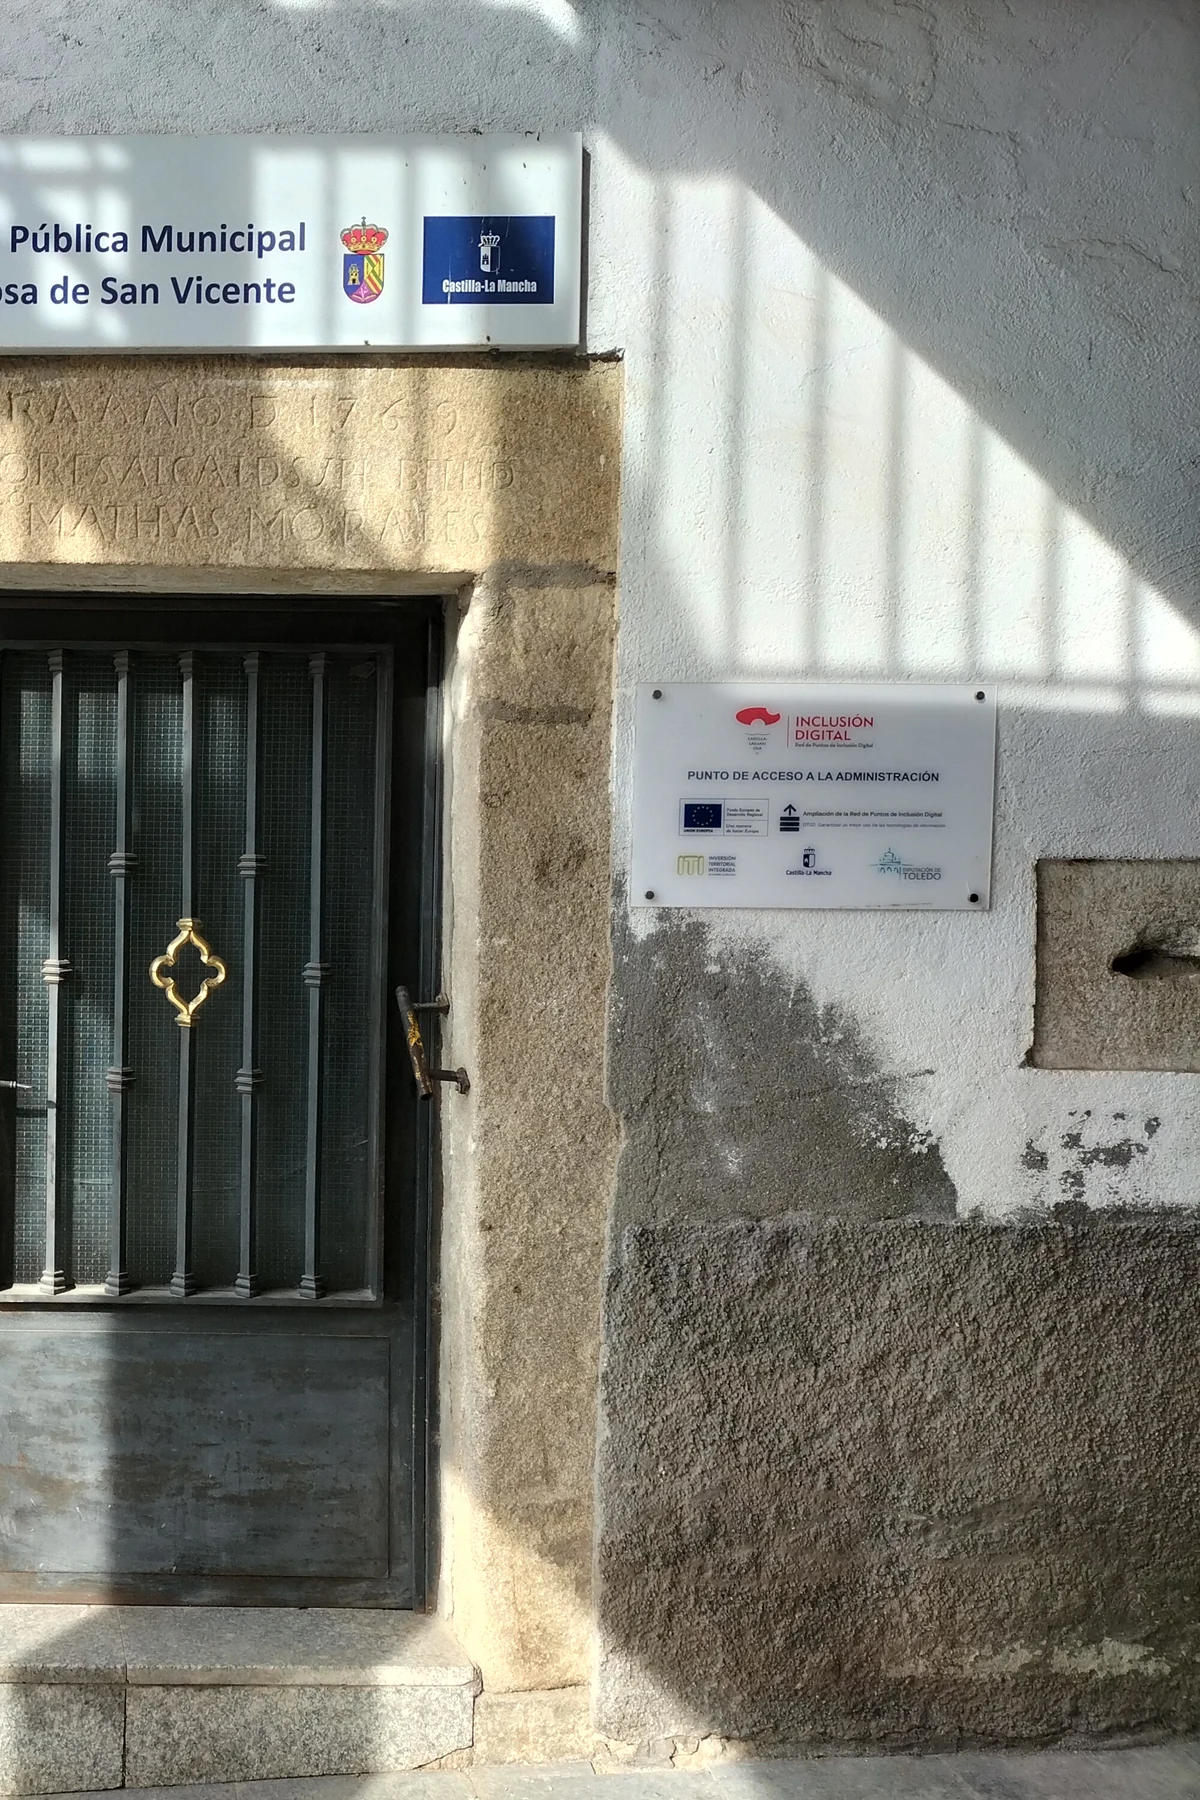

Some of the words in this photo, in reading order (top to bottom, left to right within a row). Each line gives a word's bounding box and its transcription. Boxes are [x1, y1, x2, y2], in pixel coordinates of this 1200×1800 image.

[10, 223, 129, 253] Pública
[141, 222, 306, 259] Municipal
[50, 275, 90, 305] de
[100, 276, 160, 305] San
[170, 275, 296, 305] Vicente
[442, 279, 496, 293] Castilla-La
[497, 279, 538, 293] Mancha
[796, 713, 874, 728] INCLUSIÓN
[795, 729, 851, 741] DIGITAL
[687, 771, 730, 780] PUNTO
[732, 771, 749, 780] DE
[751, 771, 804, 781] ACCESO
[806, 771, 815, 781] A
[817, 771, 833, 781] LA
[835, 770, 940, 782] ADMINISTRACIÓN
[902, 872, 942, 881] TOLEDO
